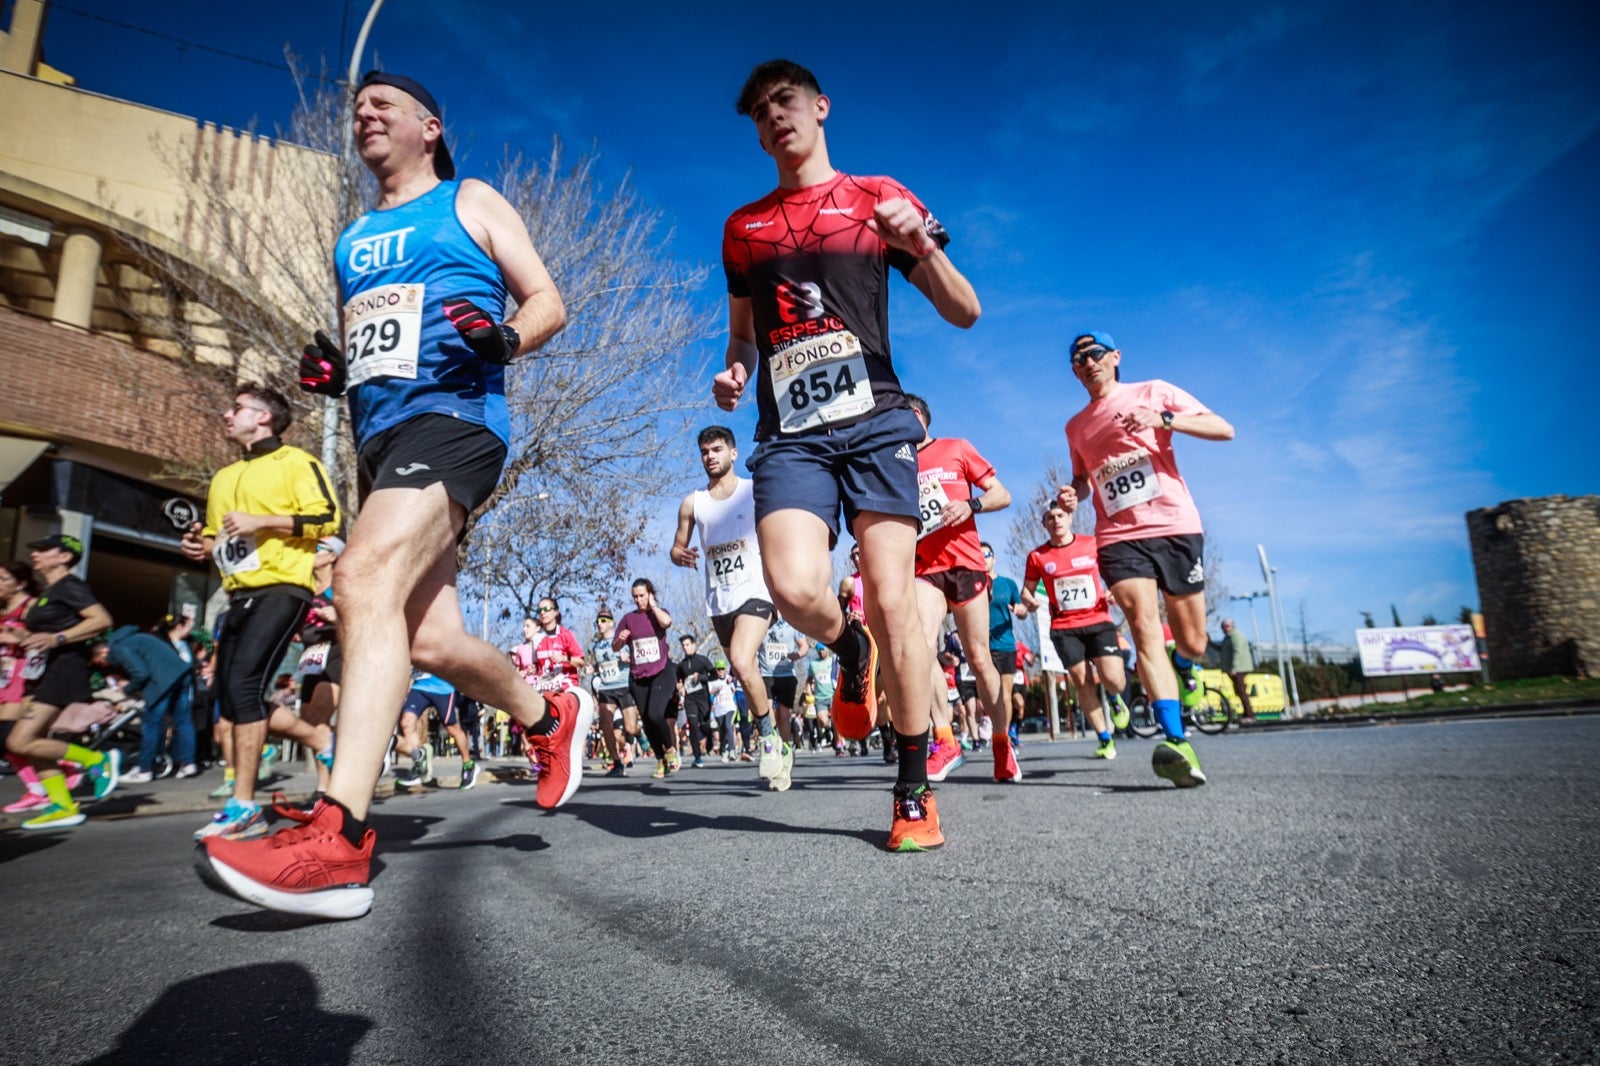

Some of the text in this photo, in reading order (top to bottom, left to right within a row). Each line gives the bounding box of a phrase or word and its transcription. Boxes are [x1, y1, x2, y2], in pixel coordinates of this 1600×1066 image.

[347, 318, 401, 366] 529
[787, 341, 842, 369] FONDO
[788, 364, 856, 411] 854
[1104, 470, 1146, 501] 389
[714, 555, 745, 576] 224
[1061, 587, 1088, 602] 271
